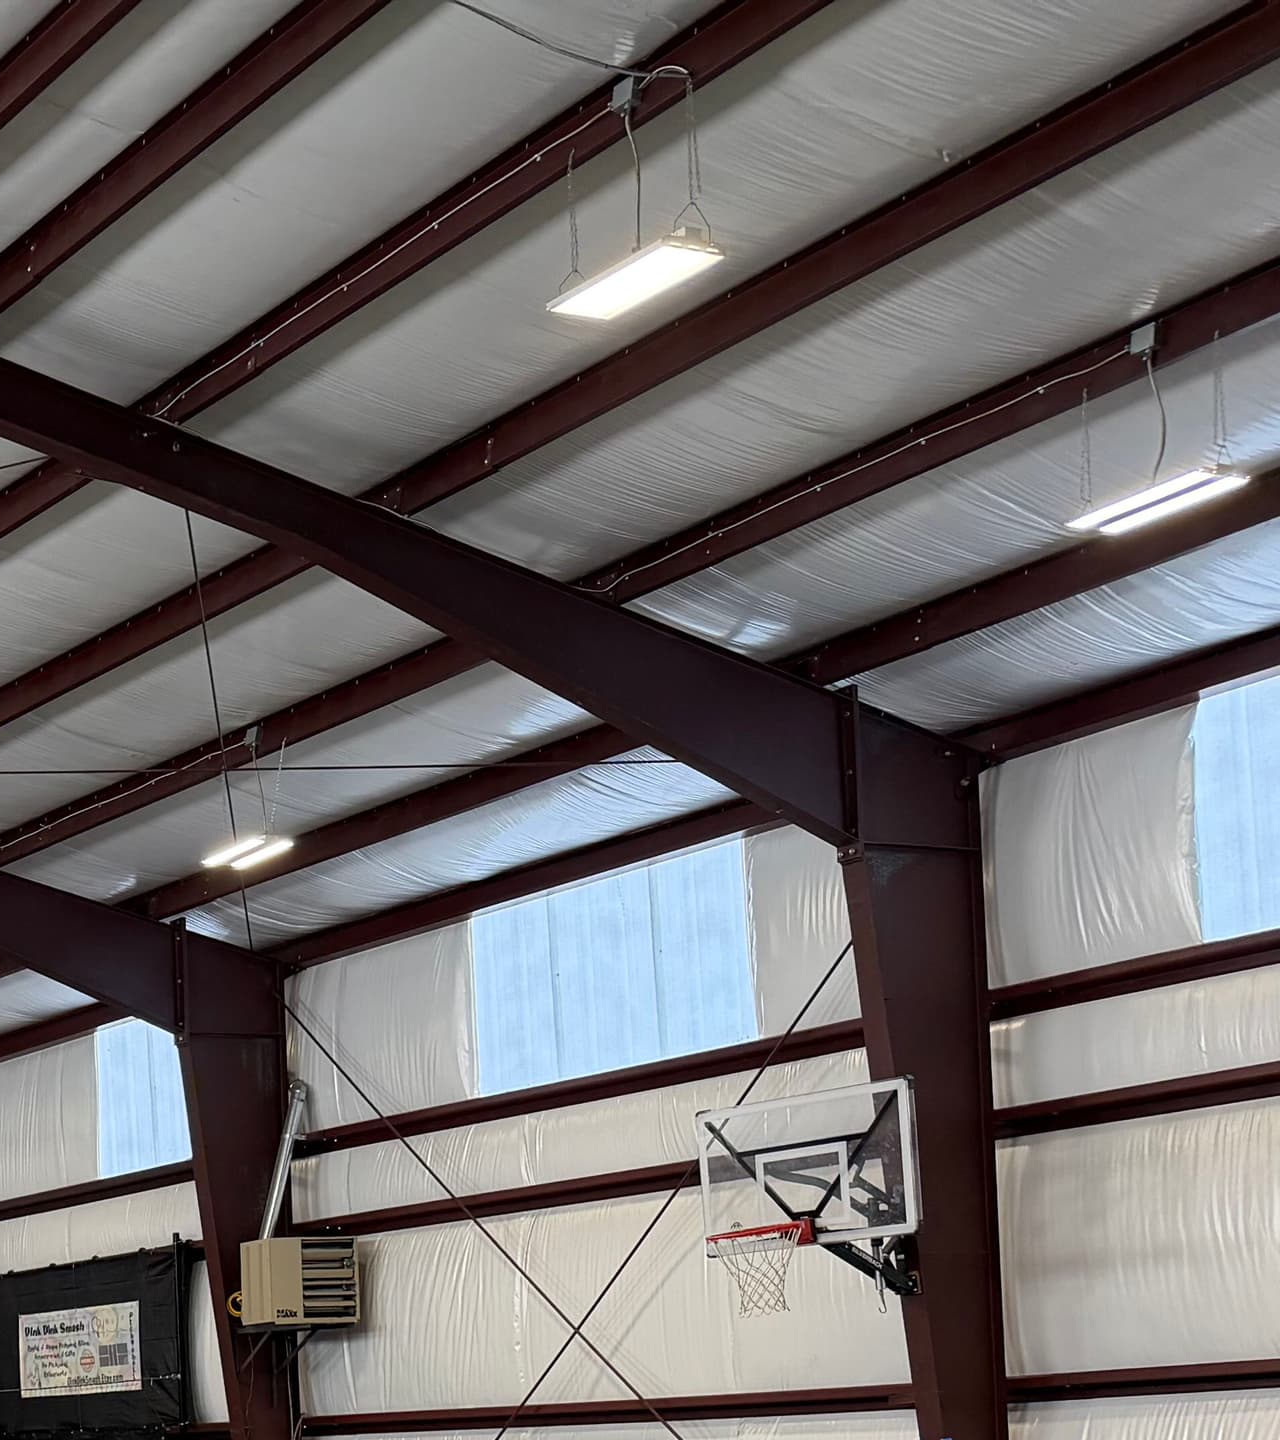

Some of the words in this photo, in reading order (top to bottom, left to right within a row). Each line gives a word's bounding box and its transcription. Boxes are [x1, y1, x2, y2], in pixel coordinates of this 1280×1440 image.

[24, 1326, 42, 1337] Dink
[43, 1324, 58, 1336] Dink
[60, 1321, 85, 1334] Smash
